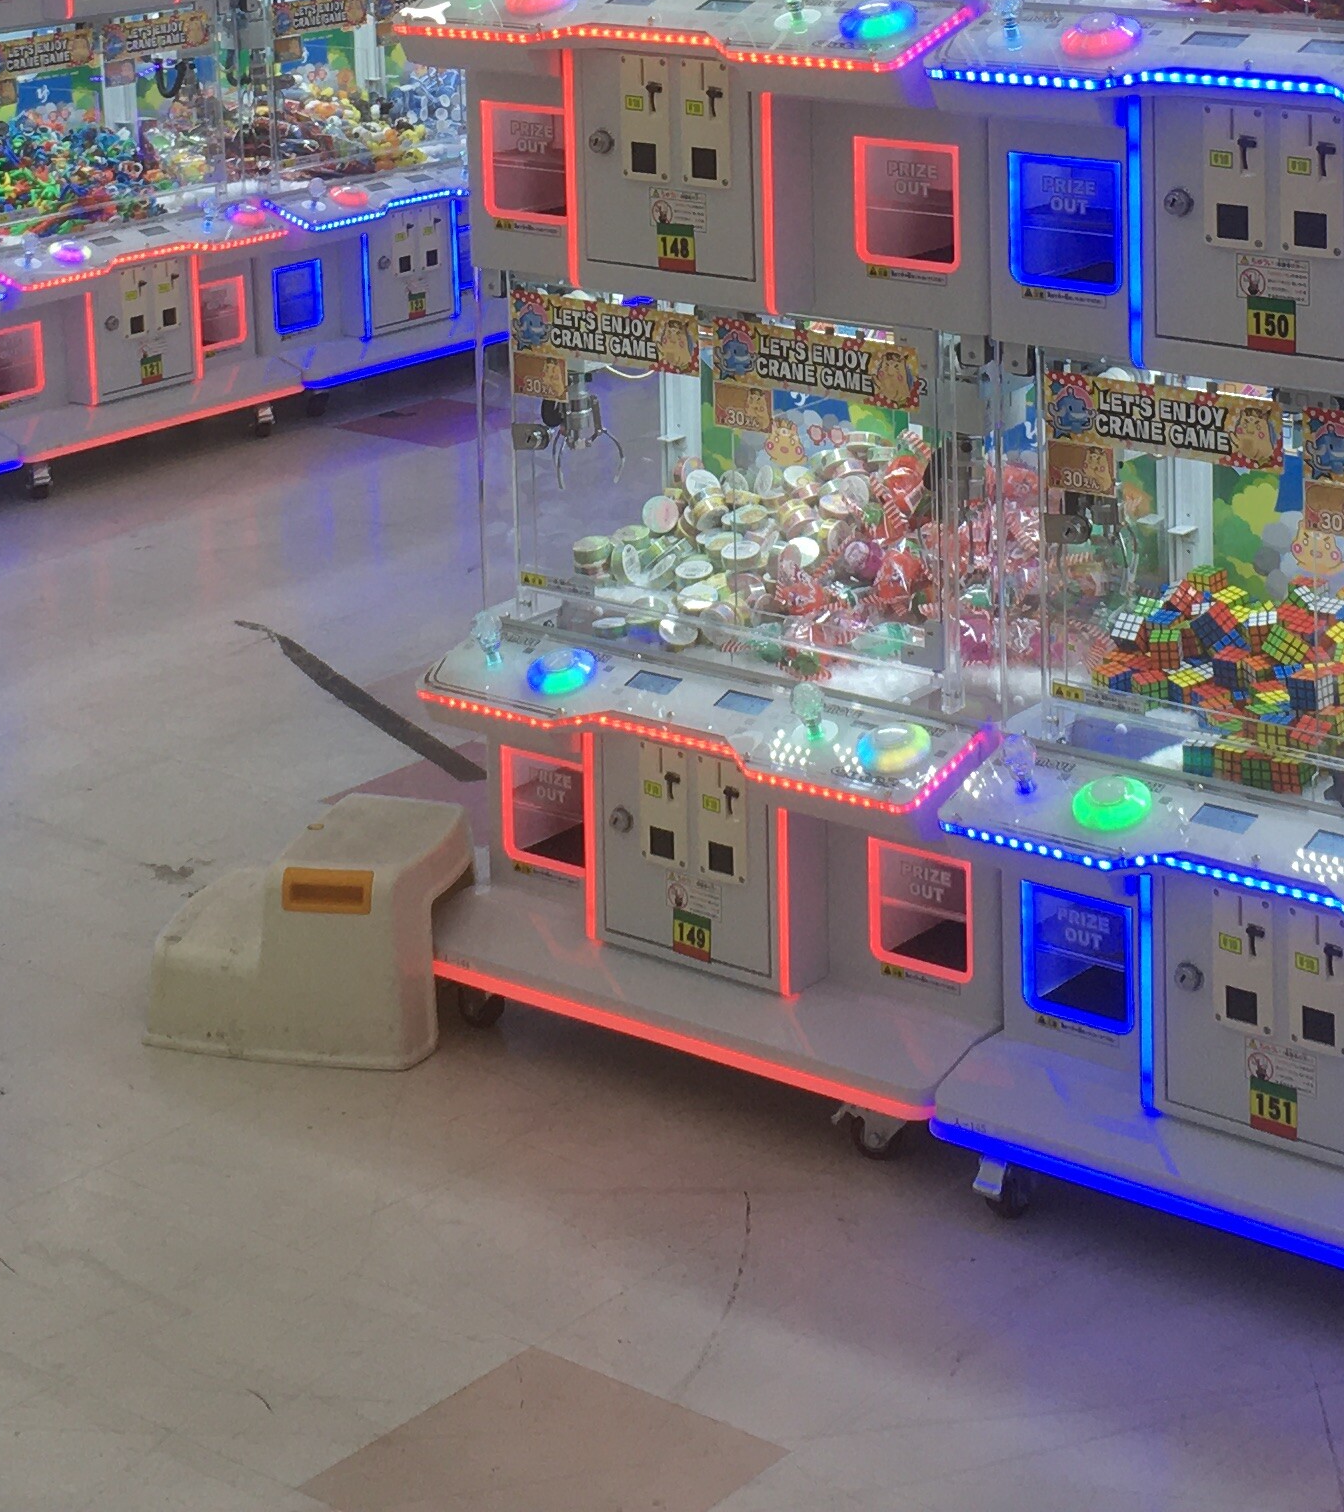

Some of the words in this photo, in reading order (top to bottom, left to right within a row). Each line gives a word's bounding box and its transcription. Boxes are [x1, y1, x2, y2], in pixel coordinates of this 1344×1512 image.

[886, 161, 938, 181] PRIZE
[894, 179, 930, 197] OUT
[659, 234, 692, 261] 148
[1253, 311, 1292, 338] 150
[1099, 389, 1153, 419] LET'S
[1159, 397, 1226, 428] ENJOY
[1094, 412, 1164, 443] CRANE
[1169, 422, 1230, 452] GAME
[676, 925, 707, 947] 149
[1255, 1095, 1295, 1127] 151
